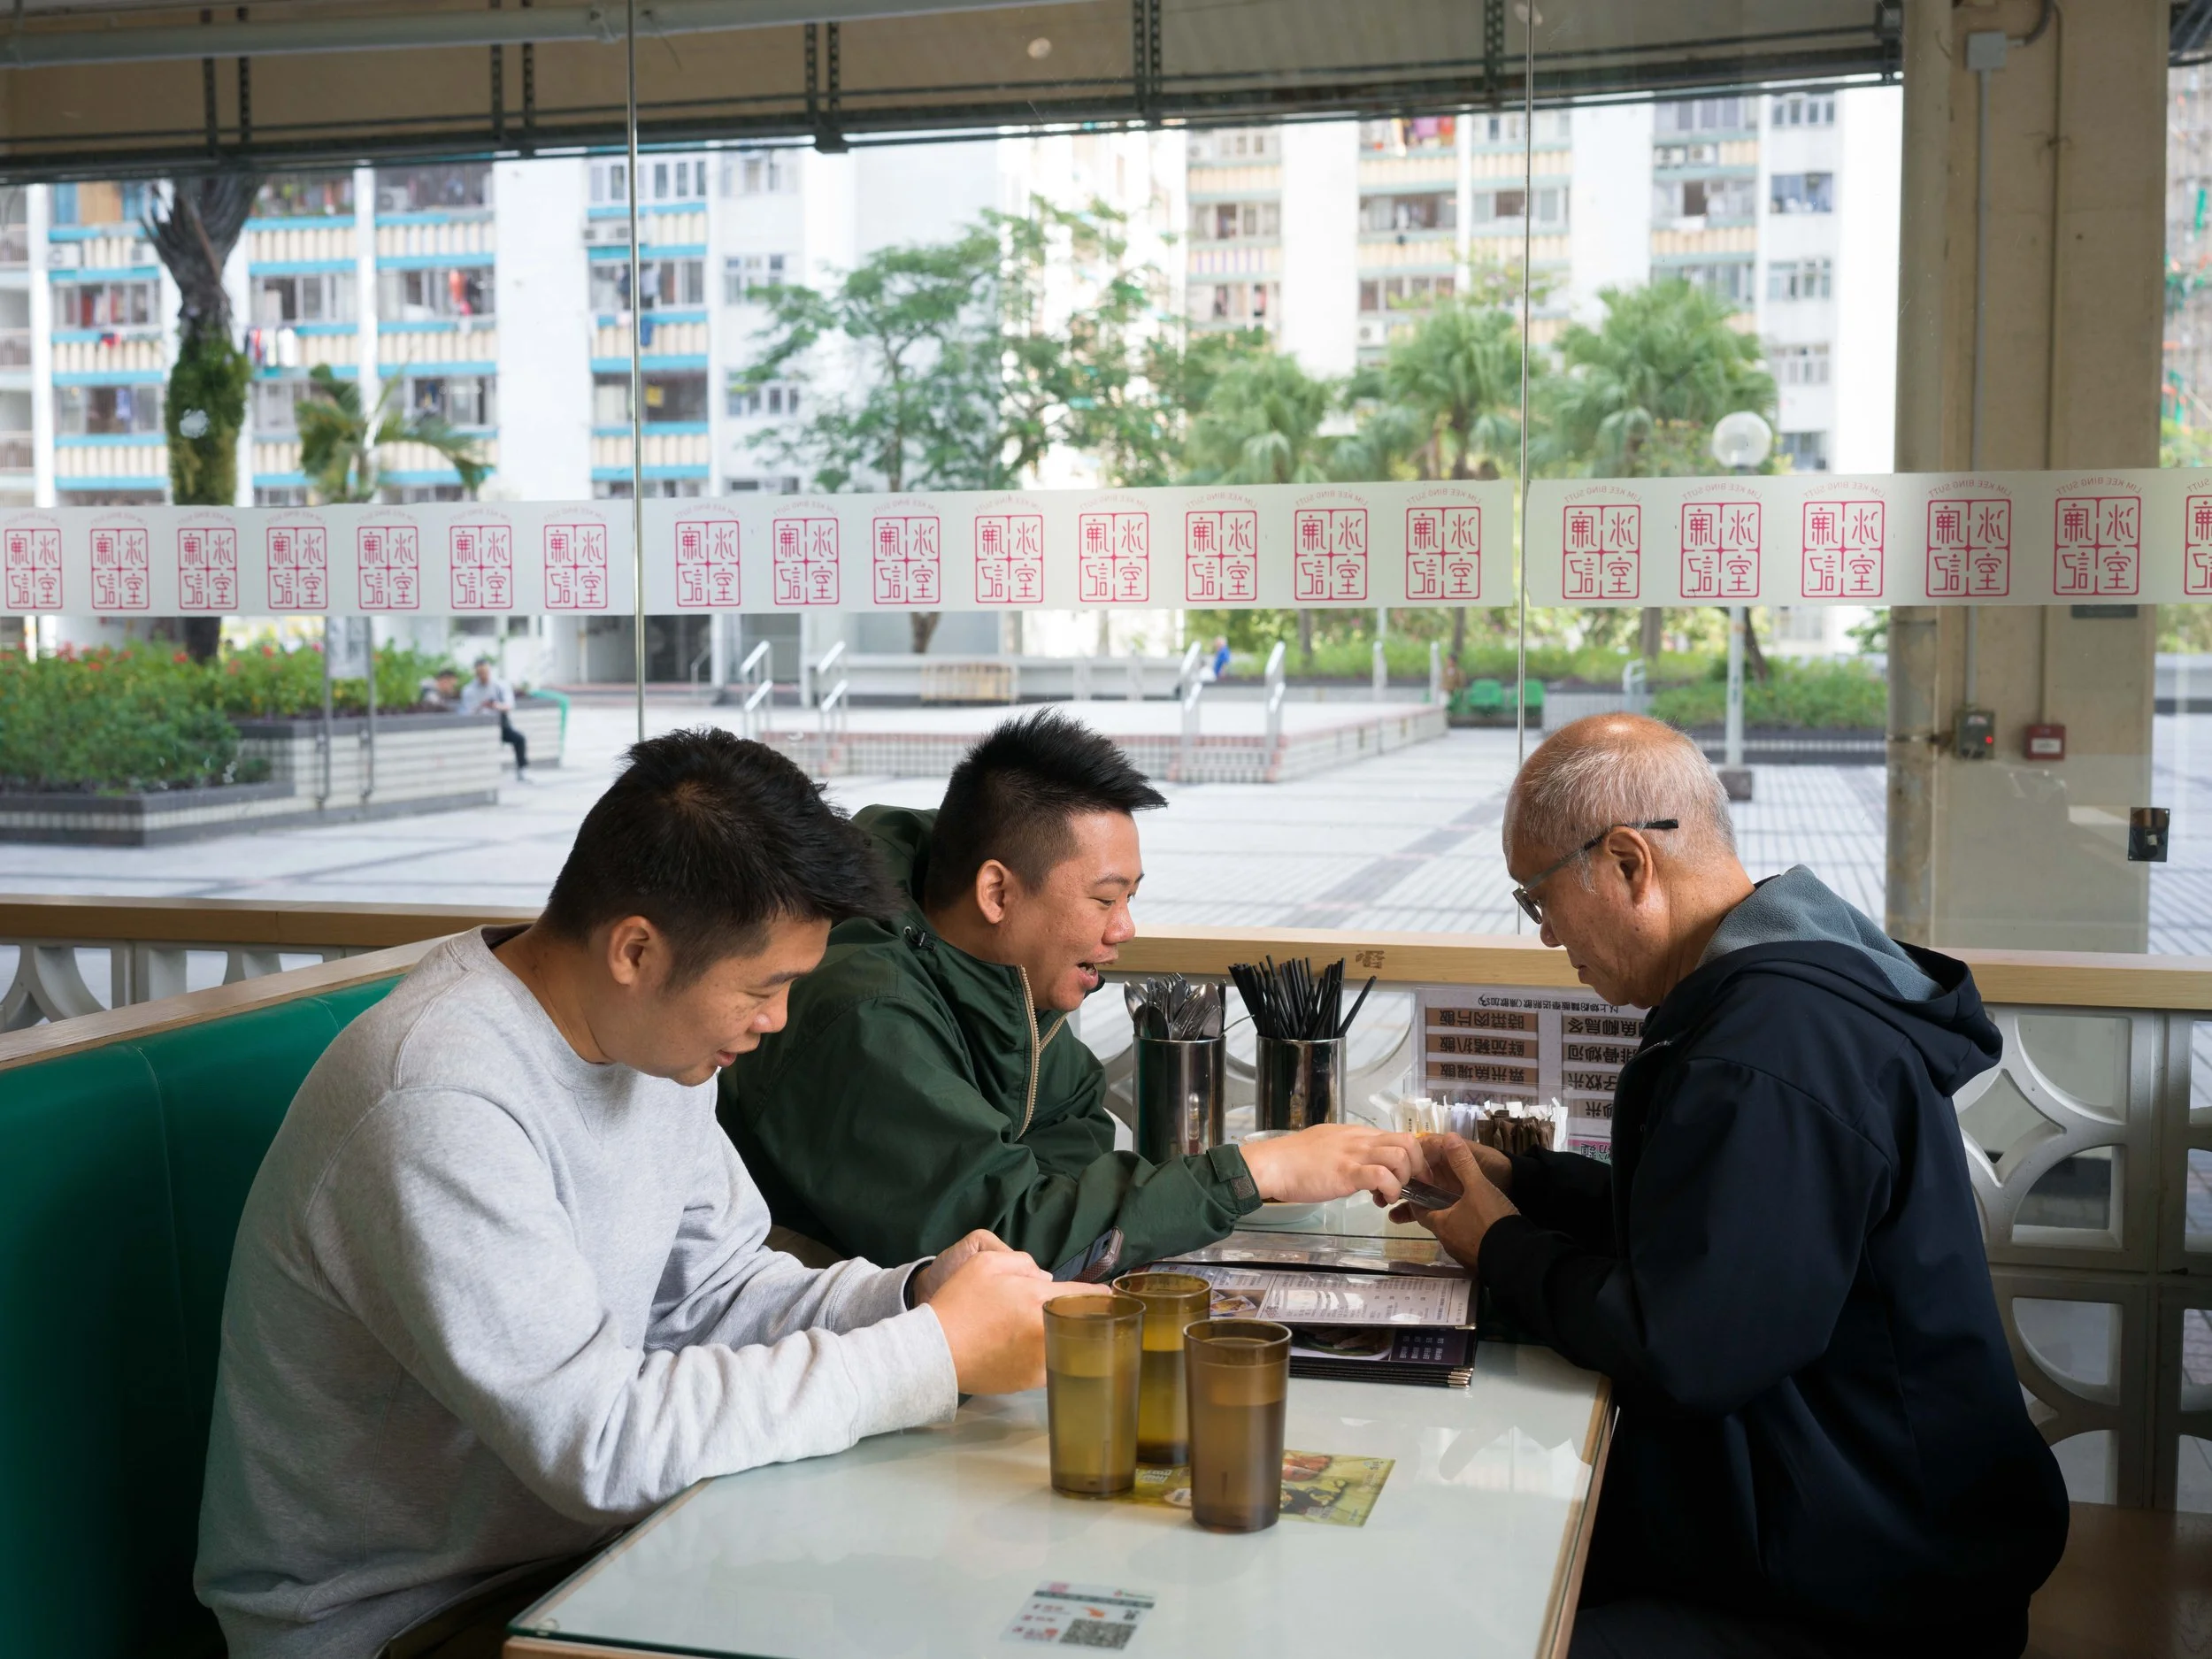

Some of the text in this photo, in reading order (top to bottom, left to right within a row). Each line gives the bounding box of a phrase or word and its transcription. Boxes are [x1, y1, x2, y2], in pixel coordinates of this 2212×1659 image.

[1440, 1010, 1524, 1029] 時菜肉片飯
[1568, 1018, 1644, 1038] 魚柳烏冬
[1440, 1036, 1525, 1056] 鮮茄豬扒飯
